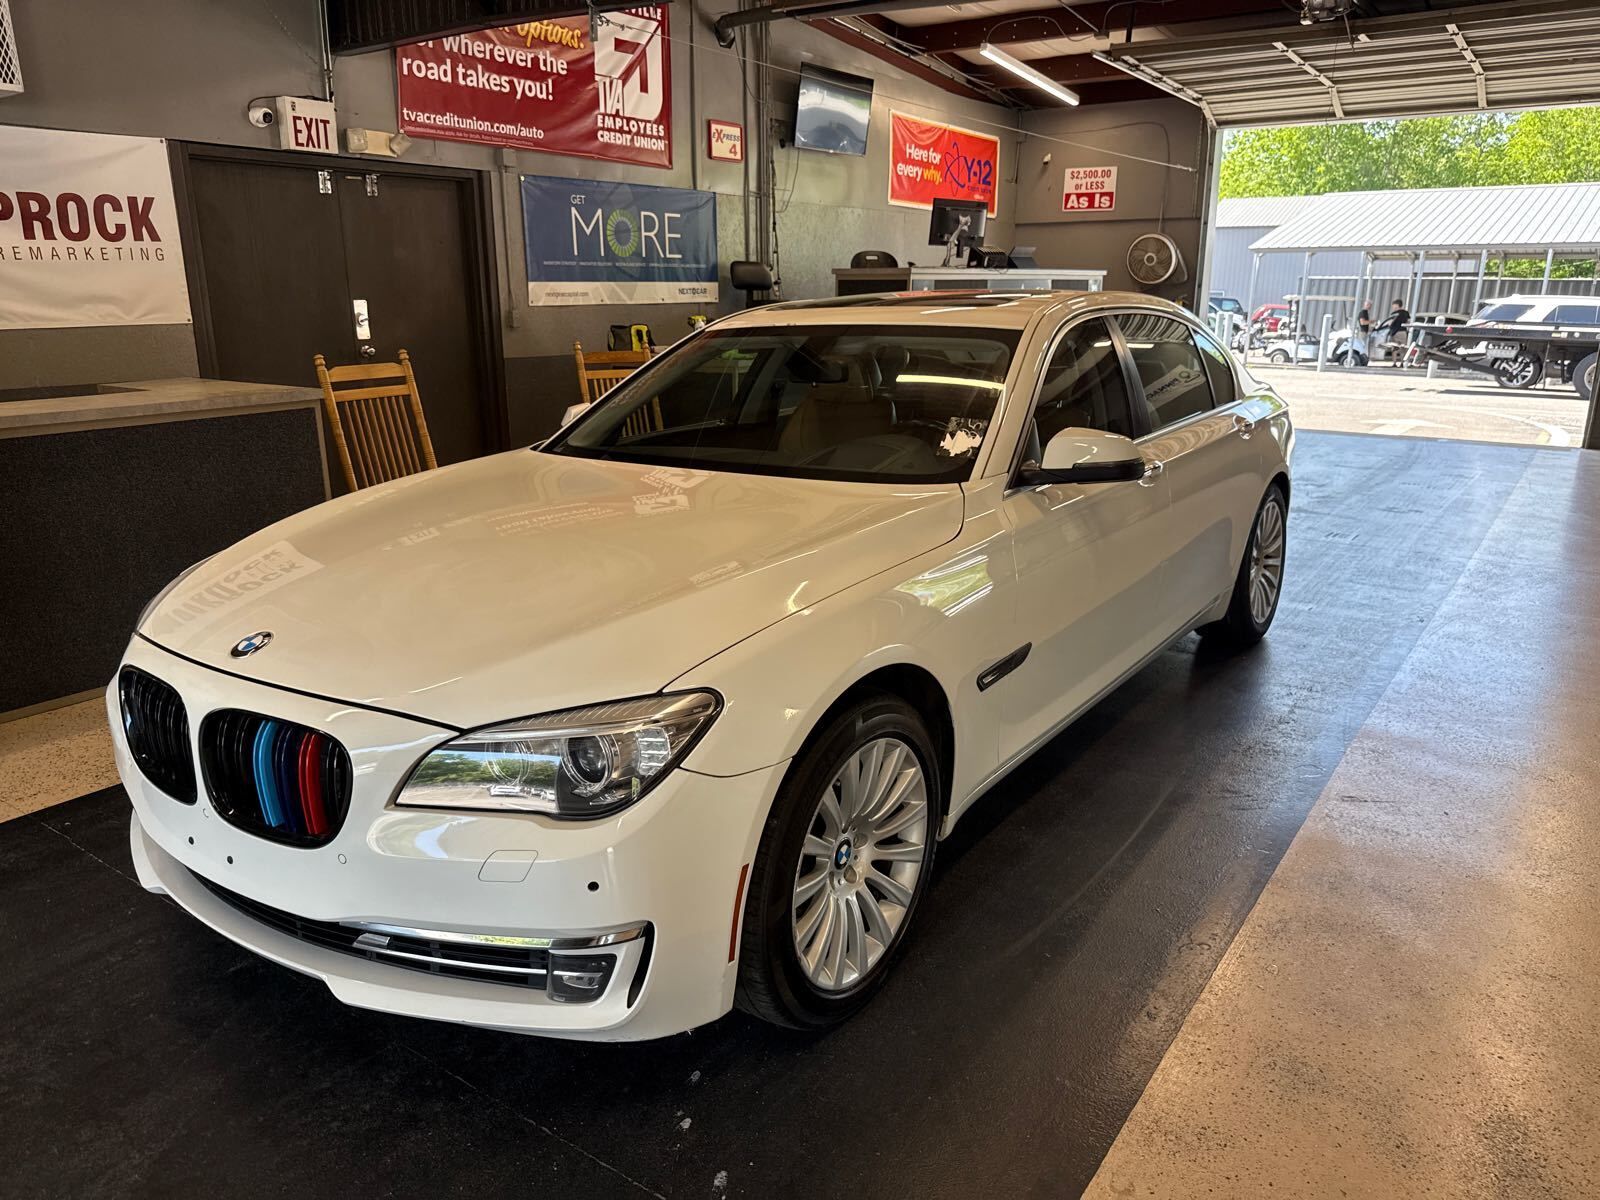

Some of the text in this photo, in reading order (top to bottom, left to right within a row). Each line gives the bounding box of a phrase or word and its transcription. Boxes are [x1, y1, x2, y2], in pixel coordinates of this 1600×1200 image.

[442, 35, 568, 75] wherever the
[402, 57, 553, 101] road takes you!
[597, 78, 624, 116] TVA
[292, 116, 330, 150] EXIT
[402, 107, 544, 139] tvacreditunion.com/auto
[597, 114, 664, 137] EMPLOYEES
[597, 130, 665, 151] CREDIT UNION
[729, 143, 738, 157] 4
[906, 143, 942, 165] Here for
[897, 162, 942, 185] every why.
[963, 156, 993, 186] Y-12
[1070, 169, 1112, 180] $2,500.00
[1074, 180, 1105, 191] or LESS
[570, 194, 586, 205] GET
[1066, 193, 1111, 209] As Is
[570, 206, 683, 259] MORE
